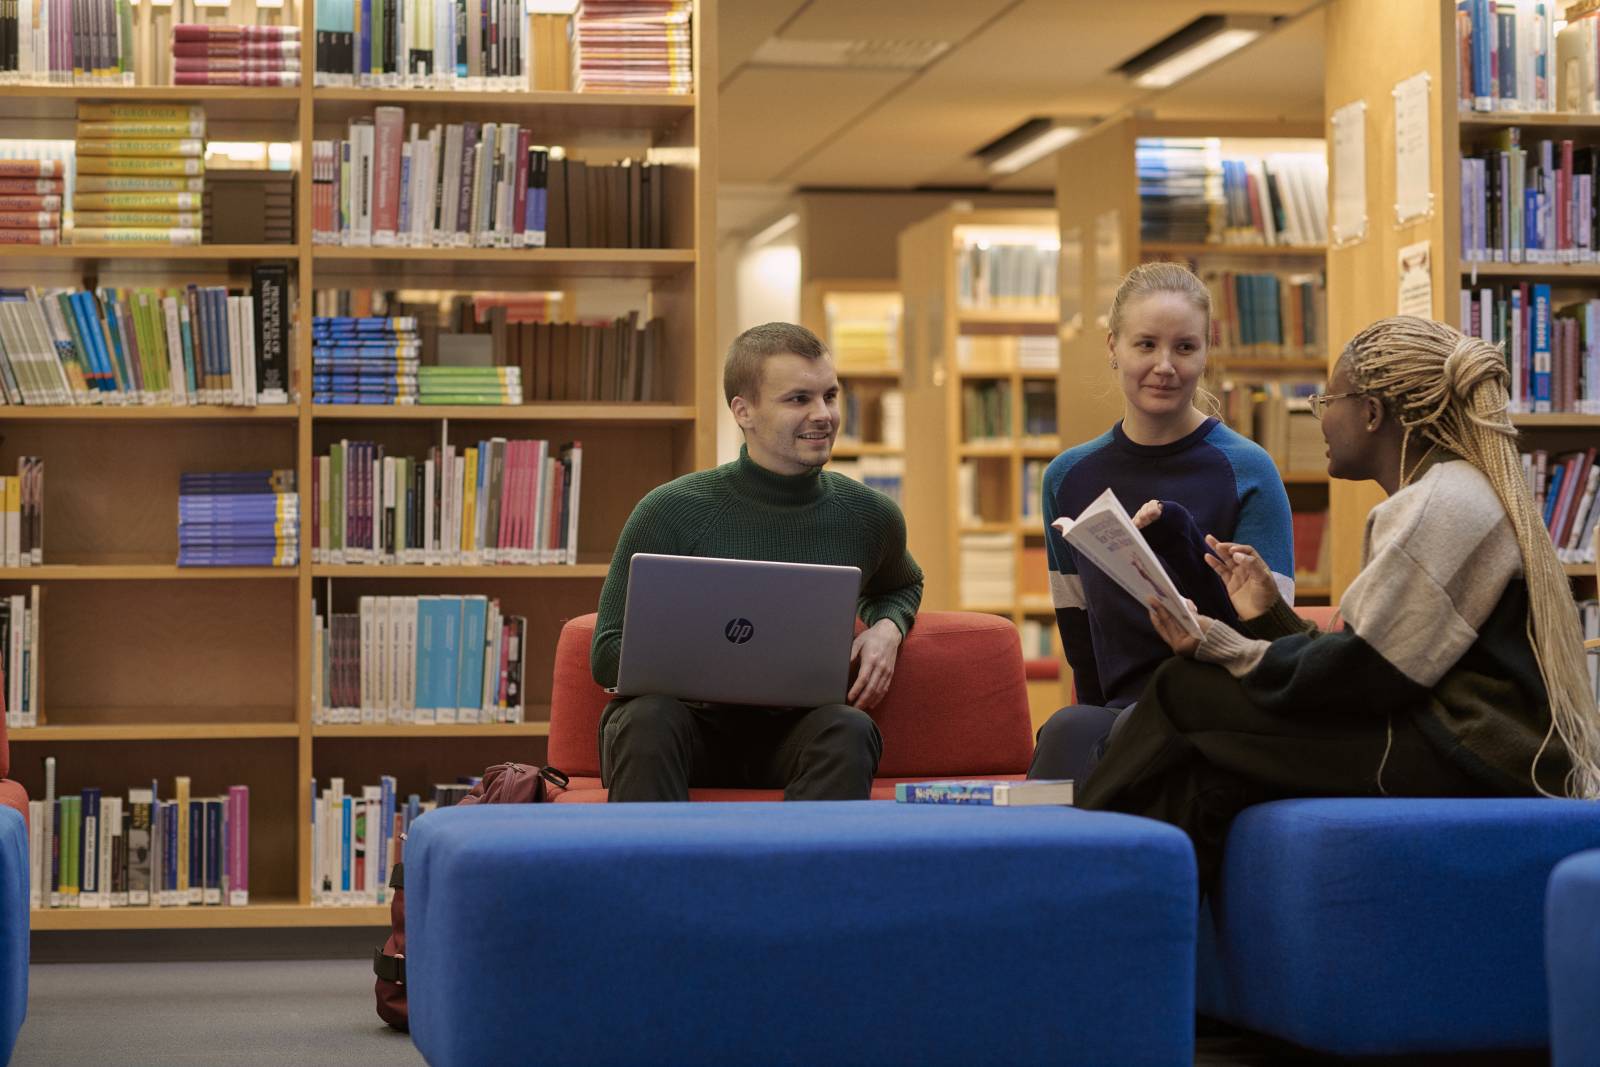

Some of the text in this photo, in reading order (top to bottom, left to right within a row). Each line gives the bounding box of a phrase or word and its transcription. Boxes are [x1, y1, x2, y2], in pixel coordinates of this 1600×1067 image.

[262, 280, 271, 317] NEURAL
[272, 285, 280, 353] PRINCIPLES OF
[728, 618, 752, 643] hp
